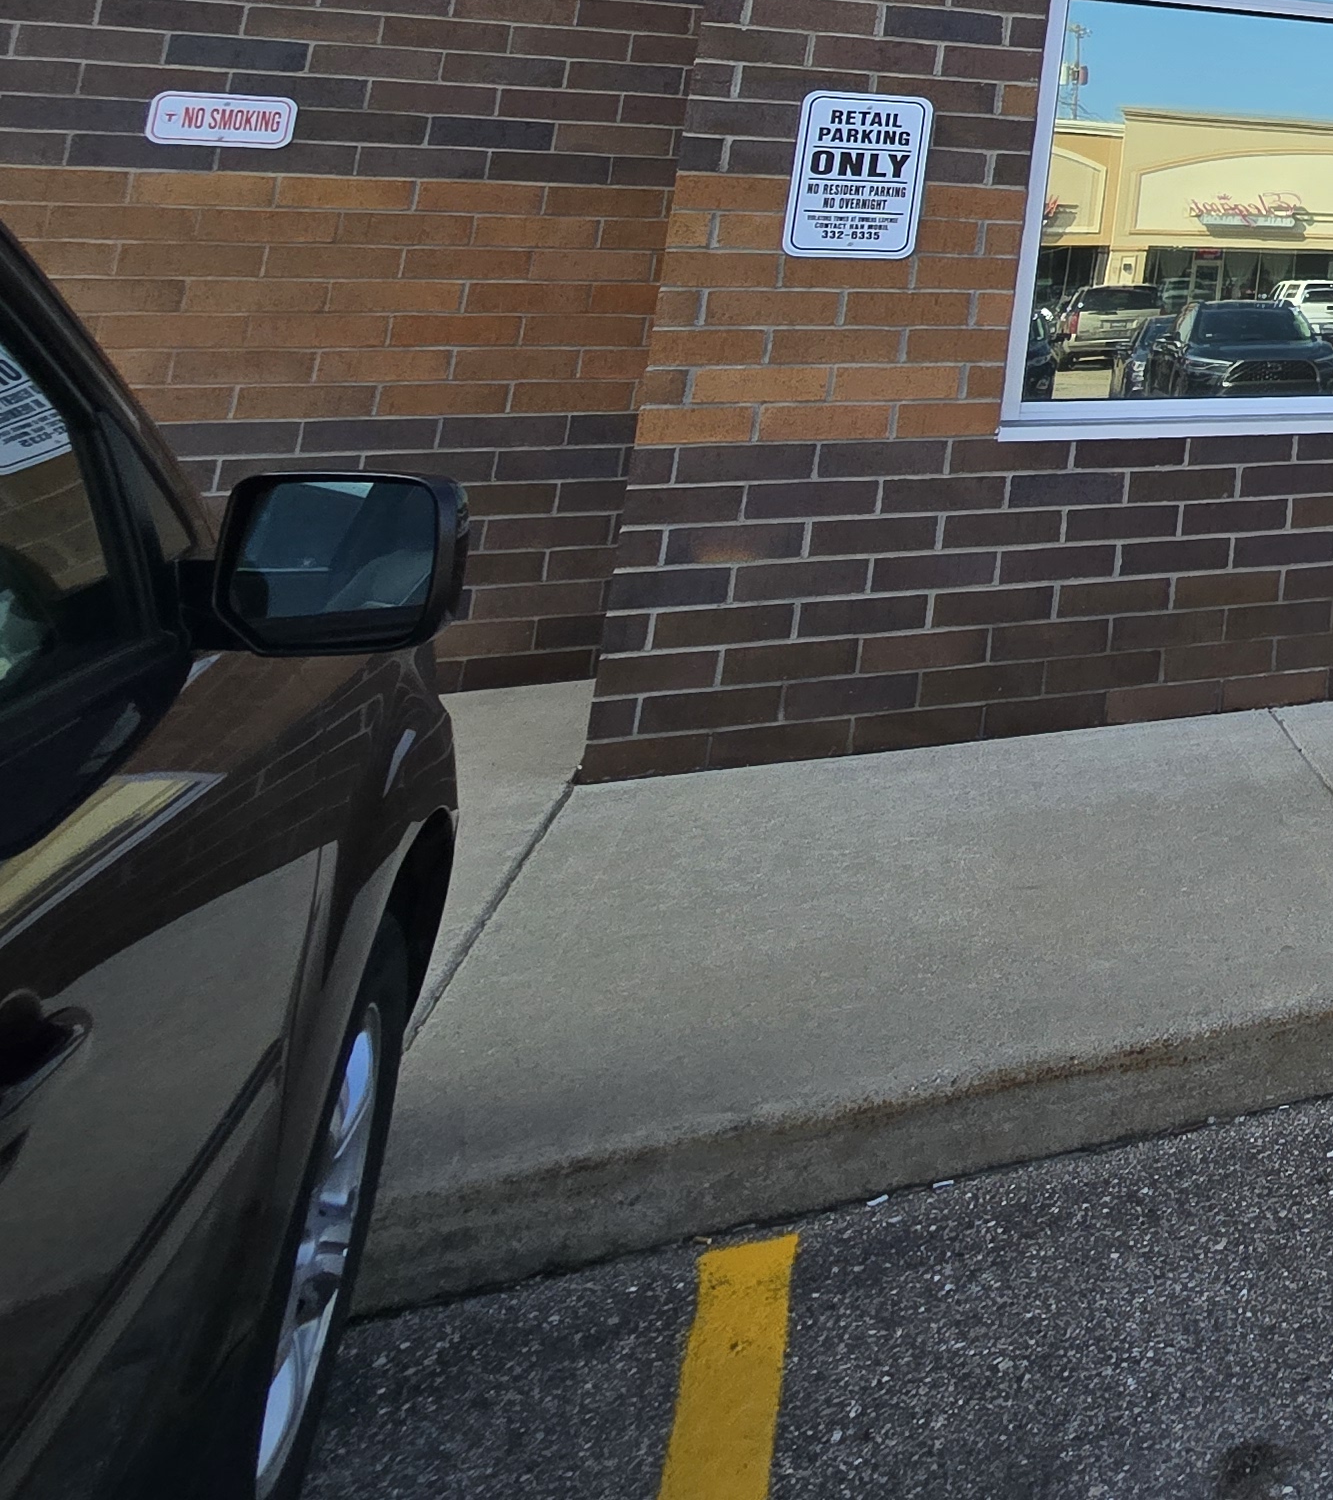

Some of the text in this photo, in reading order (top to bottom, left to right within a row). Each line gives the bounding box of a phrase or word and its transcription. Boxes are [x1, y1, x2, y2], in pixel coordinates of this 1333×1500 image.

[181, 106, 206, 129] NO
[208, 108, 282, 133] SMOKING
[830, 109, 903, 128] RETAIL
[817, 127, 911, 146] PARKING
[810, 150, 911, 179] ONLY
[806, 183, 907, 198] NO RESIDENT PARKING
[822, 198, 888, 211] NO OVERNIGHT
[814, 222, 847, 230] CONTACT
[821, 230, 880, 240] 332-6335
